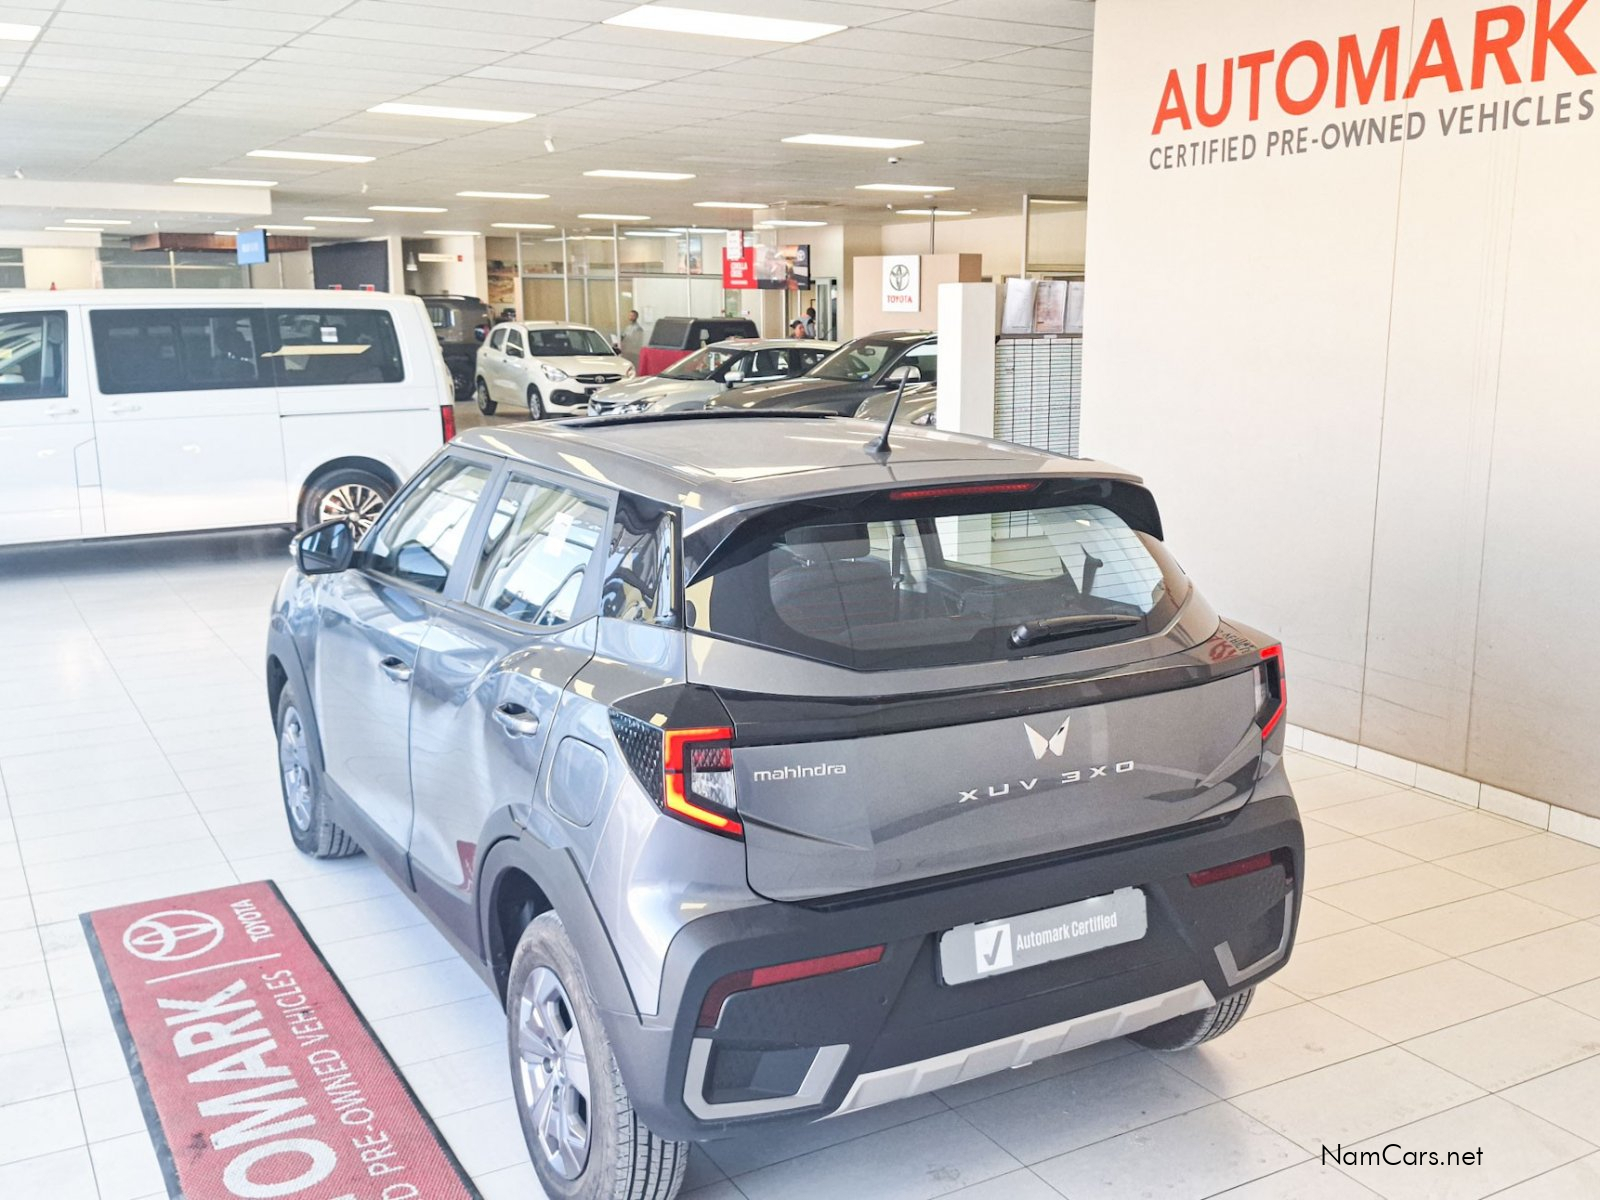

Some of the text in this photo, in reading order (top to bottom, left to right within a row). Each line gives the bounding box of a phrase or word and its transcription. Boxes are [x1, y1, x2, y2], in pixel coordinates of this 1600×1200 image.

[1151, 0, 1597, 135] AUTOMARK
[1149, 89, 1595, 170] CERTIFIED PRE-OWNED VEHICLES
[886, 294, 913, 304] TOYOTA
[753, 763, 847, 782] mahindra
[958, 760, 1135, 803] XUV 3XO
[230, 898, 275, 943] TOYOTA
[1016, 911, 1118, 951] Automark Certified
[261, 969, 329, 1047] VEHICLES
[156, 978, 357, 1200] OMARK
[307, 1049, 406, 1177] PRE-OWNED
